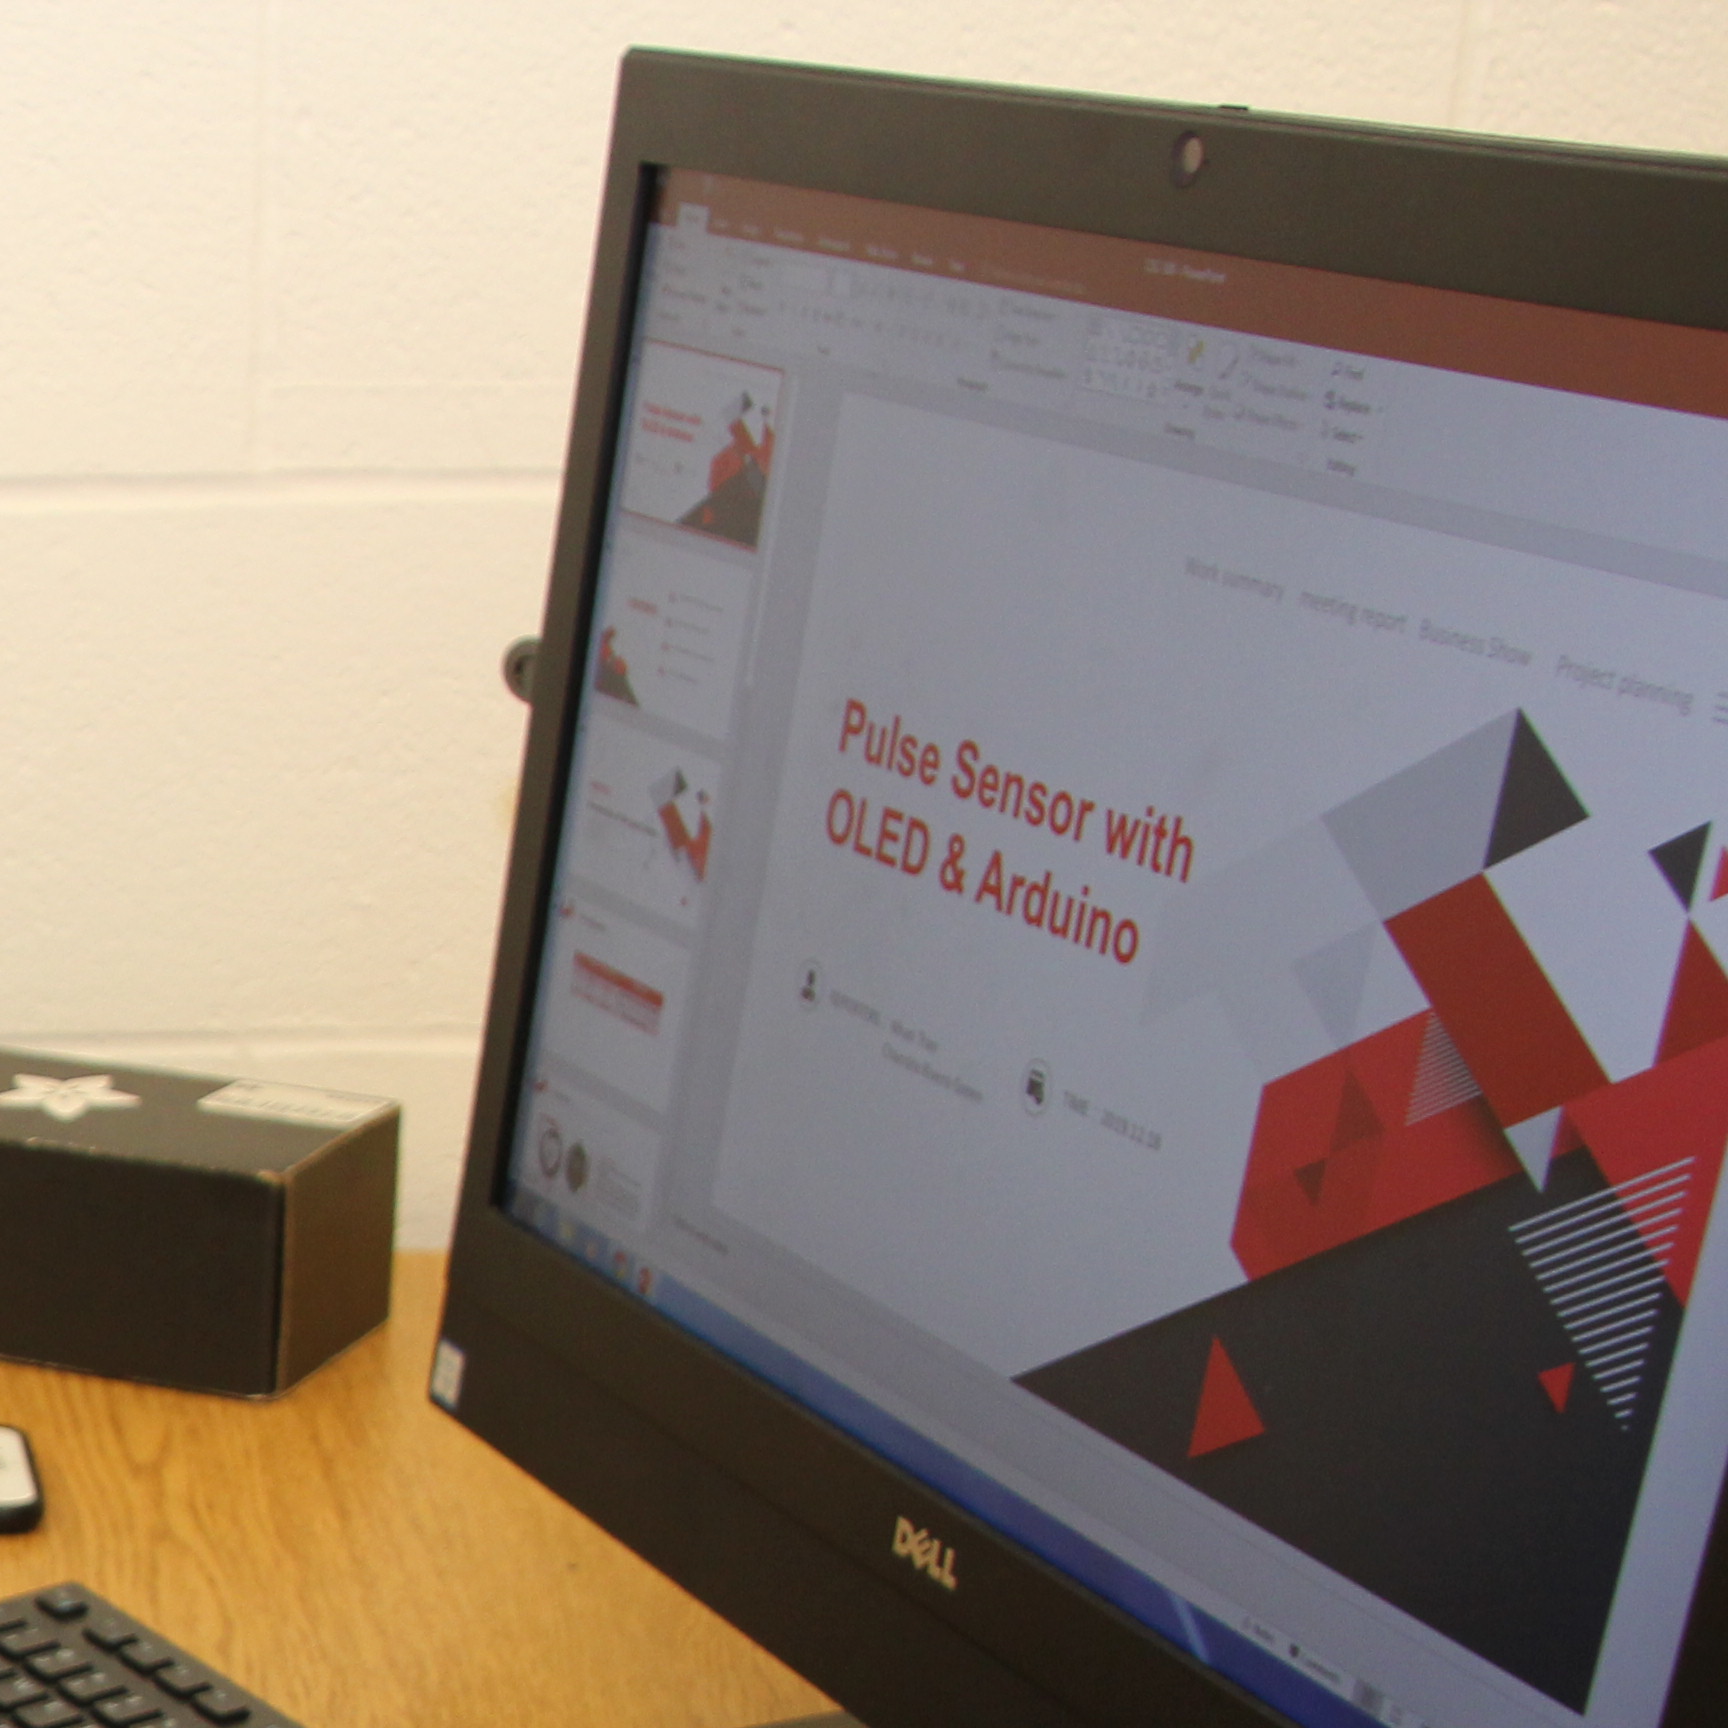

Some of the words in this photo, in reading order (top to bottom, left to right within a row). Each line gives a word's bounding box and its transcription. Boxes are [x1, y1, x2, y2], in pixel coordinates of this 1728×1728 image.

[1554, 655, 1616, 690] Project
[1617, 675, 1694, 717] planning
[839, 698, 942, 787] Pulse
[951, 738, 1096, 843] Sensor
[1105, 804, 1195, 885] with
[826, 787, 931, 877] OLED
[939, 832, 967, 896] &
[973, 850, 1141, 966] Arduino
[891, 1514, 960, 1592] DELL
